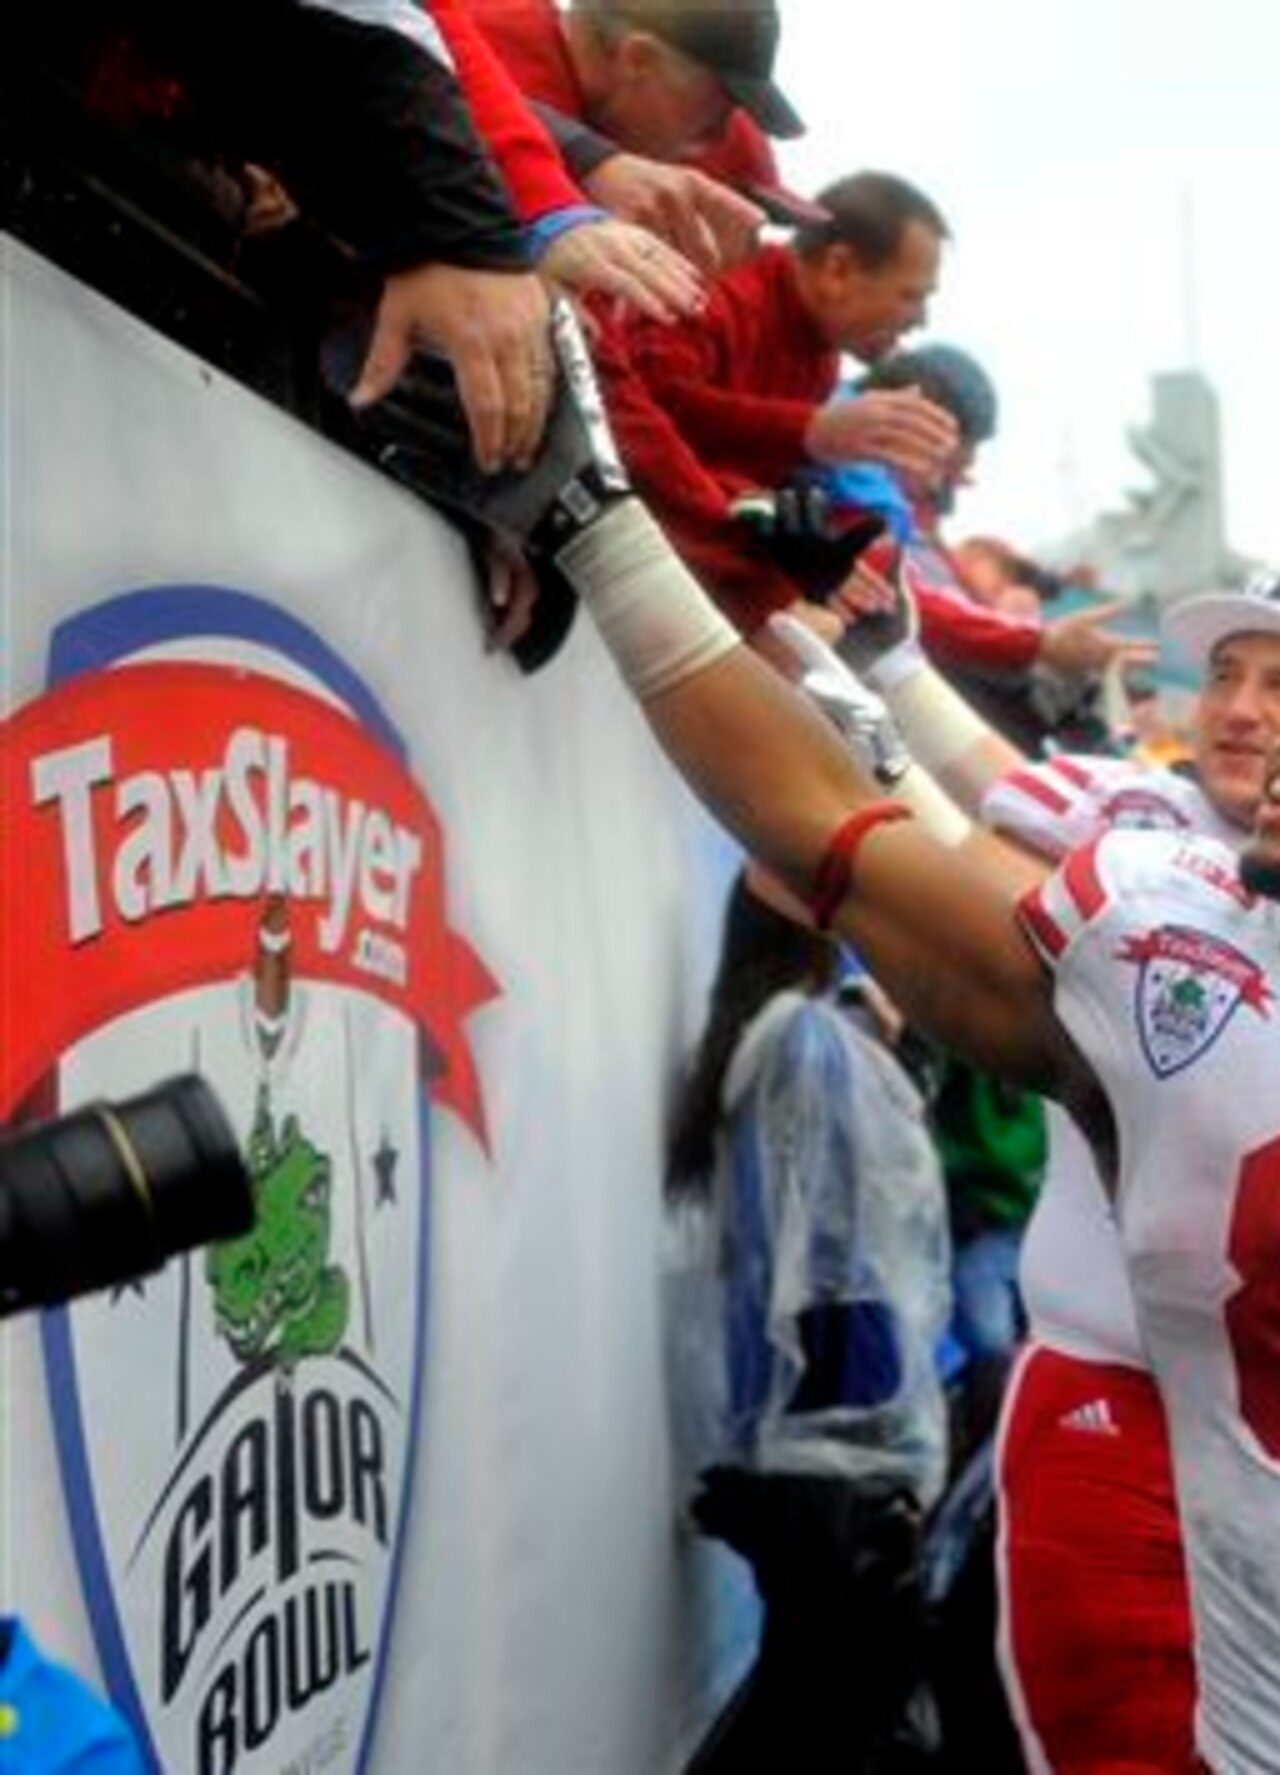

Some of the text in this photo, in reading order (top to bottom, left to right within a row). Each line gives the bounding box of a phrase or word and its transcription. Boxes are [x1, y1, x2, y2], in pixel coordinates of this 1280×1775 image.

[30, 727, 421, 953] TaxSlayer
[162, 1386, 389, 1706] GATOR
[197, 1578, 371, 1775] BOWL
